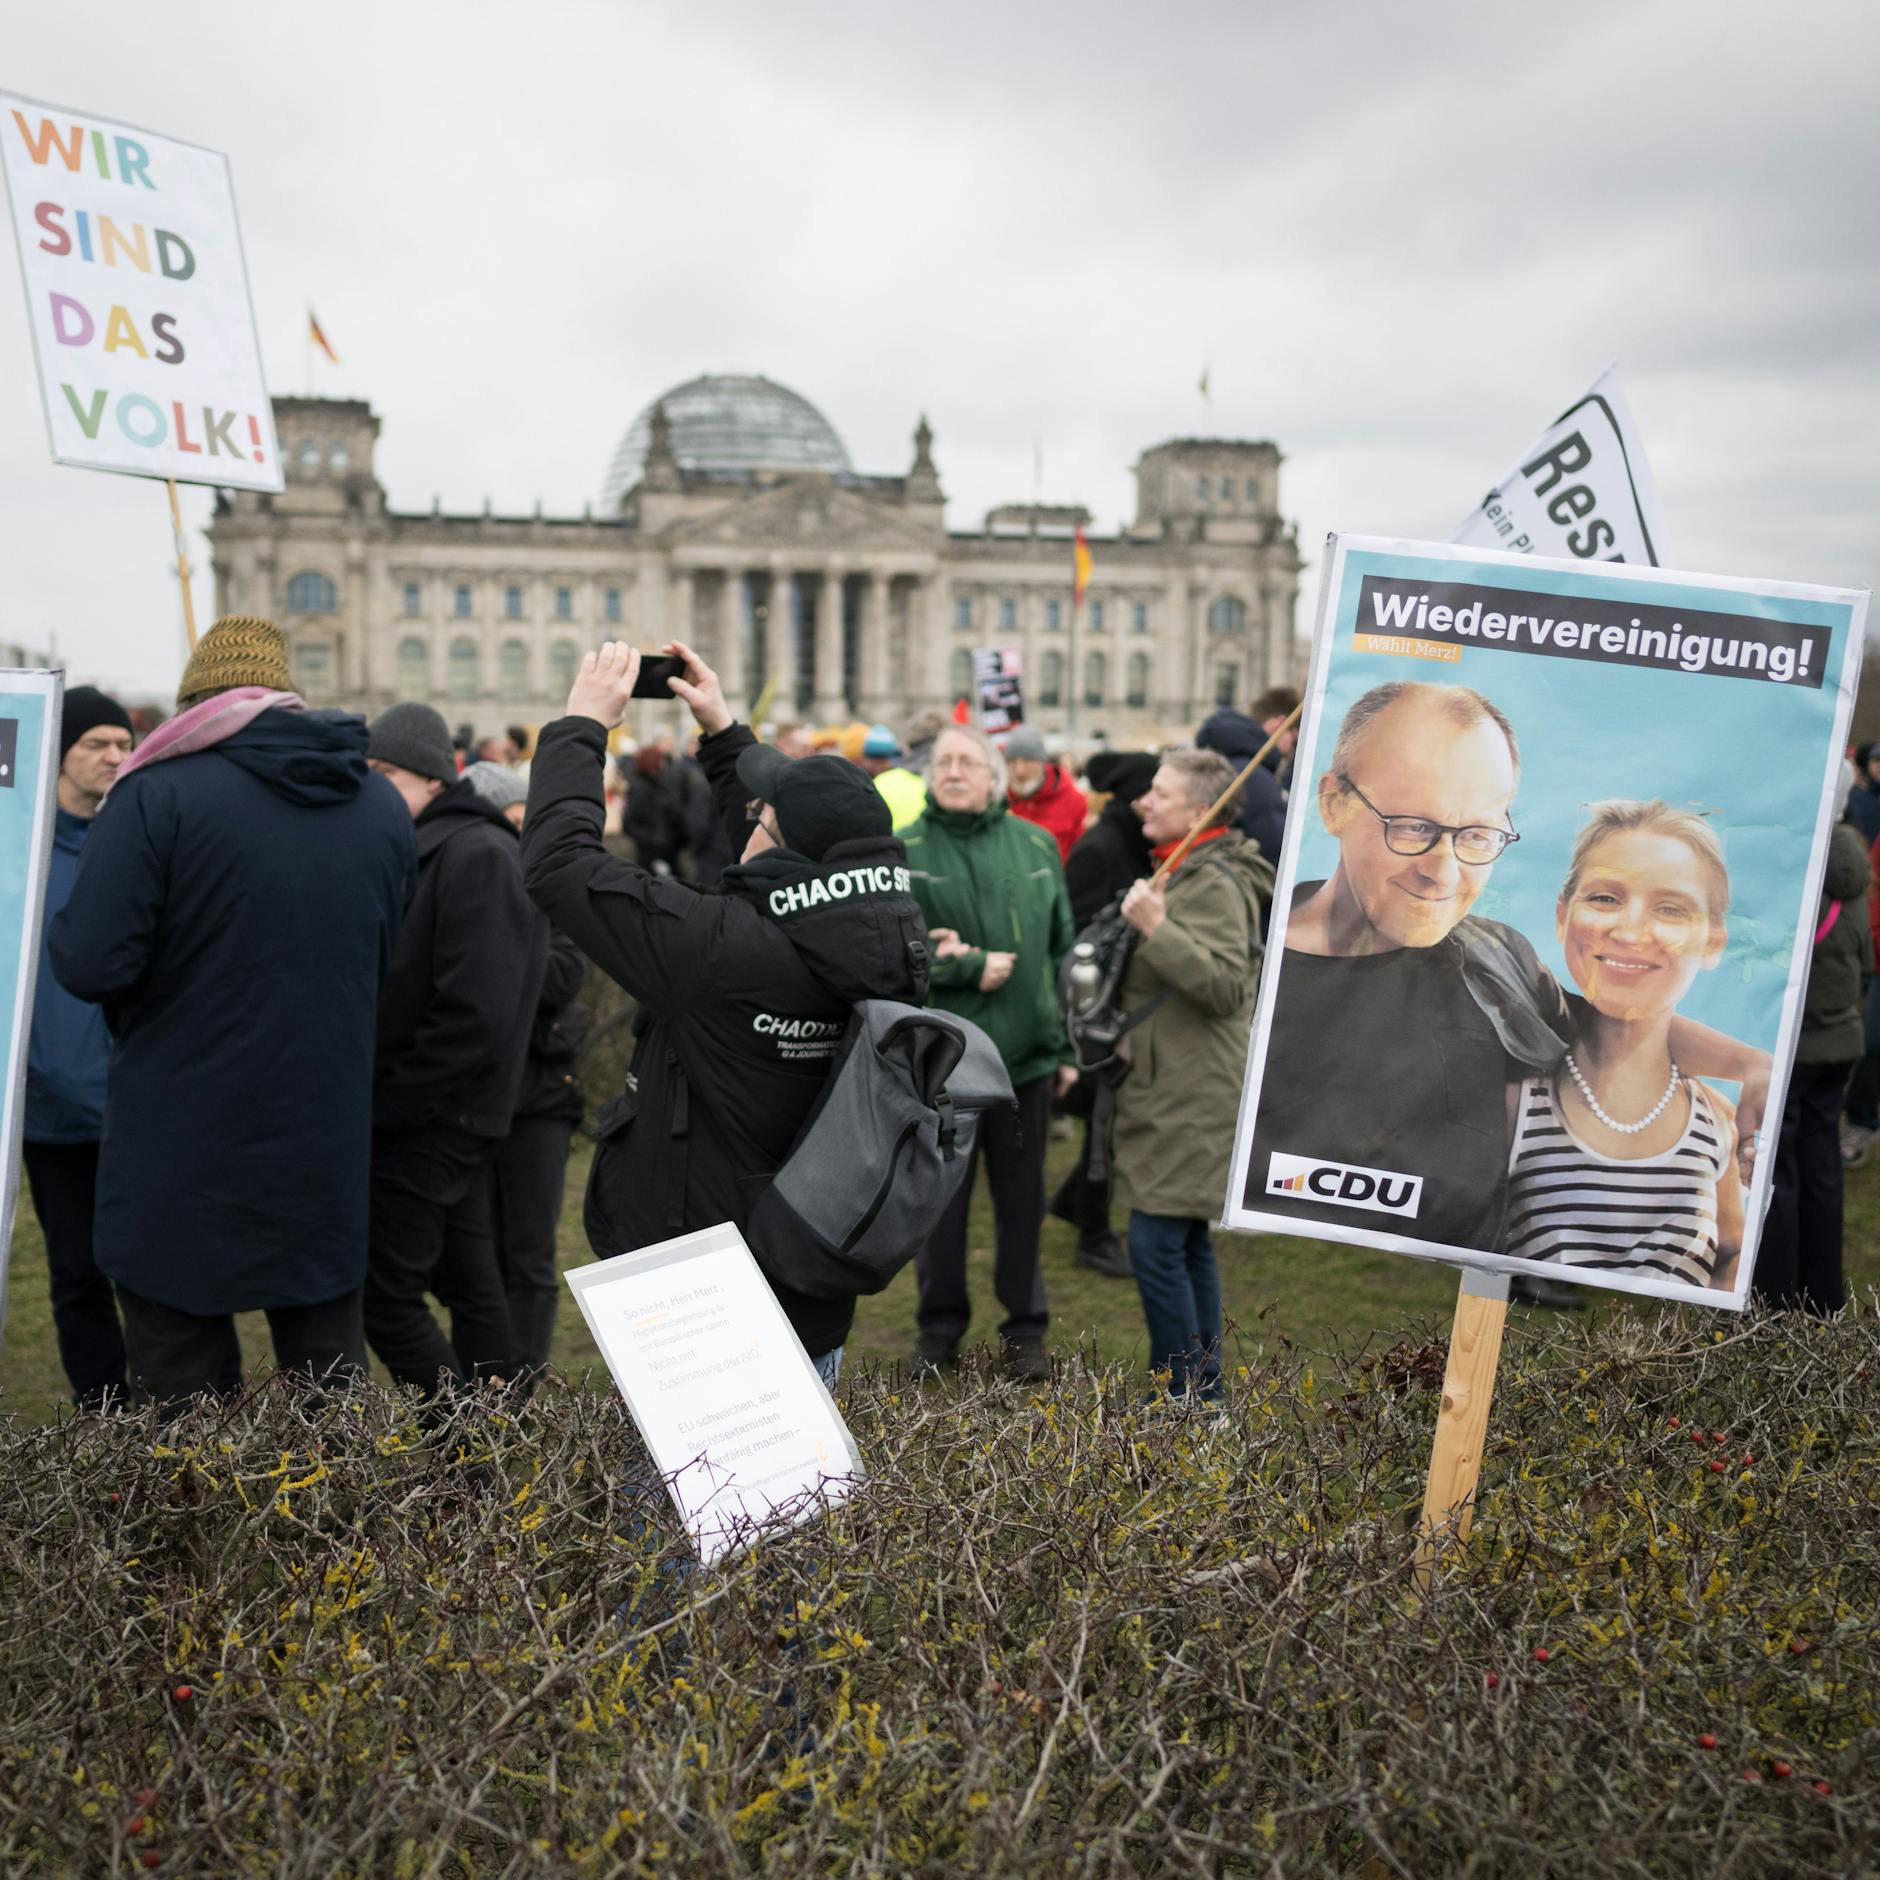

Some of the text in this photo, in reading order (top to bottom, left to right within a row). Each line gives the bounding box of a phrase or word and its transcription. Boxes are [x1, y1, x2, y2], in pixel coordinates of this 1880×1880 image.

[11, 109, 158, 191] WIR
[34, 201, 196, 281] SIND
[49, 291, 185, 365] DAS
[60, 383, 265, 464] VOLK!
[1520, 430, 1626, 563] Res
[1371, 591, 1814, 683] Wiedervereinigung!
[1416, 641, 1457, 660] Merz!
[769, 866, 892, 916] CHAOTIC
[753, 1013, 843, 1038] CHAOTIC
[1308, 1167, 1415, 1207] CDU
[622, 1307, 639, 1321] So
[639, 1296, 670, 1318] nicht,
[670, 1289, 694, 1306] Herr
[647, 1348, 697, 1374] Nicht mit
[677, 1420, 694, 1435] EU
[758, 1388, 782, 1406] aber
[753, 1430, 796, 1452] machen
